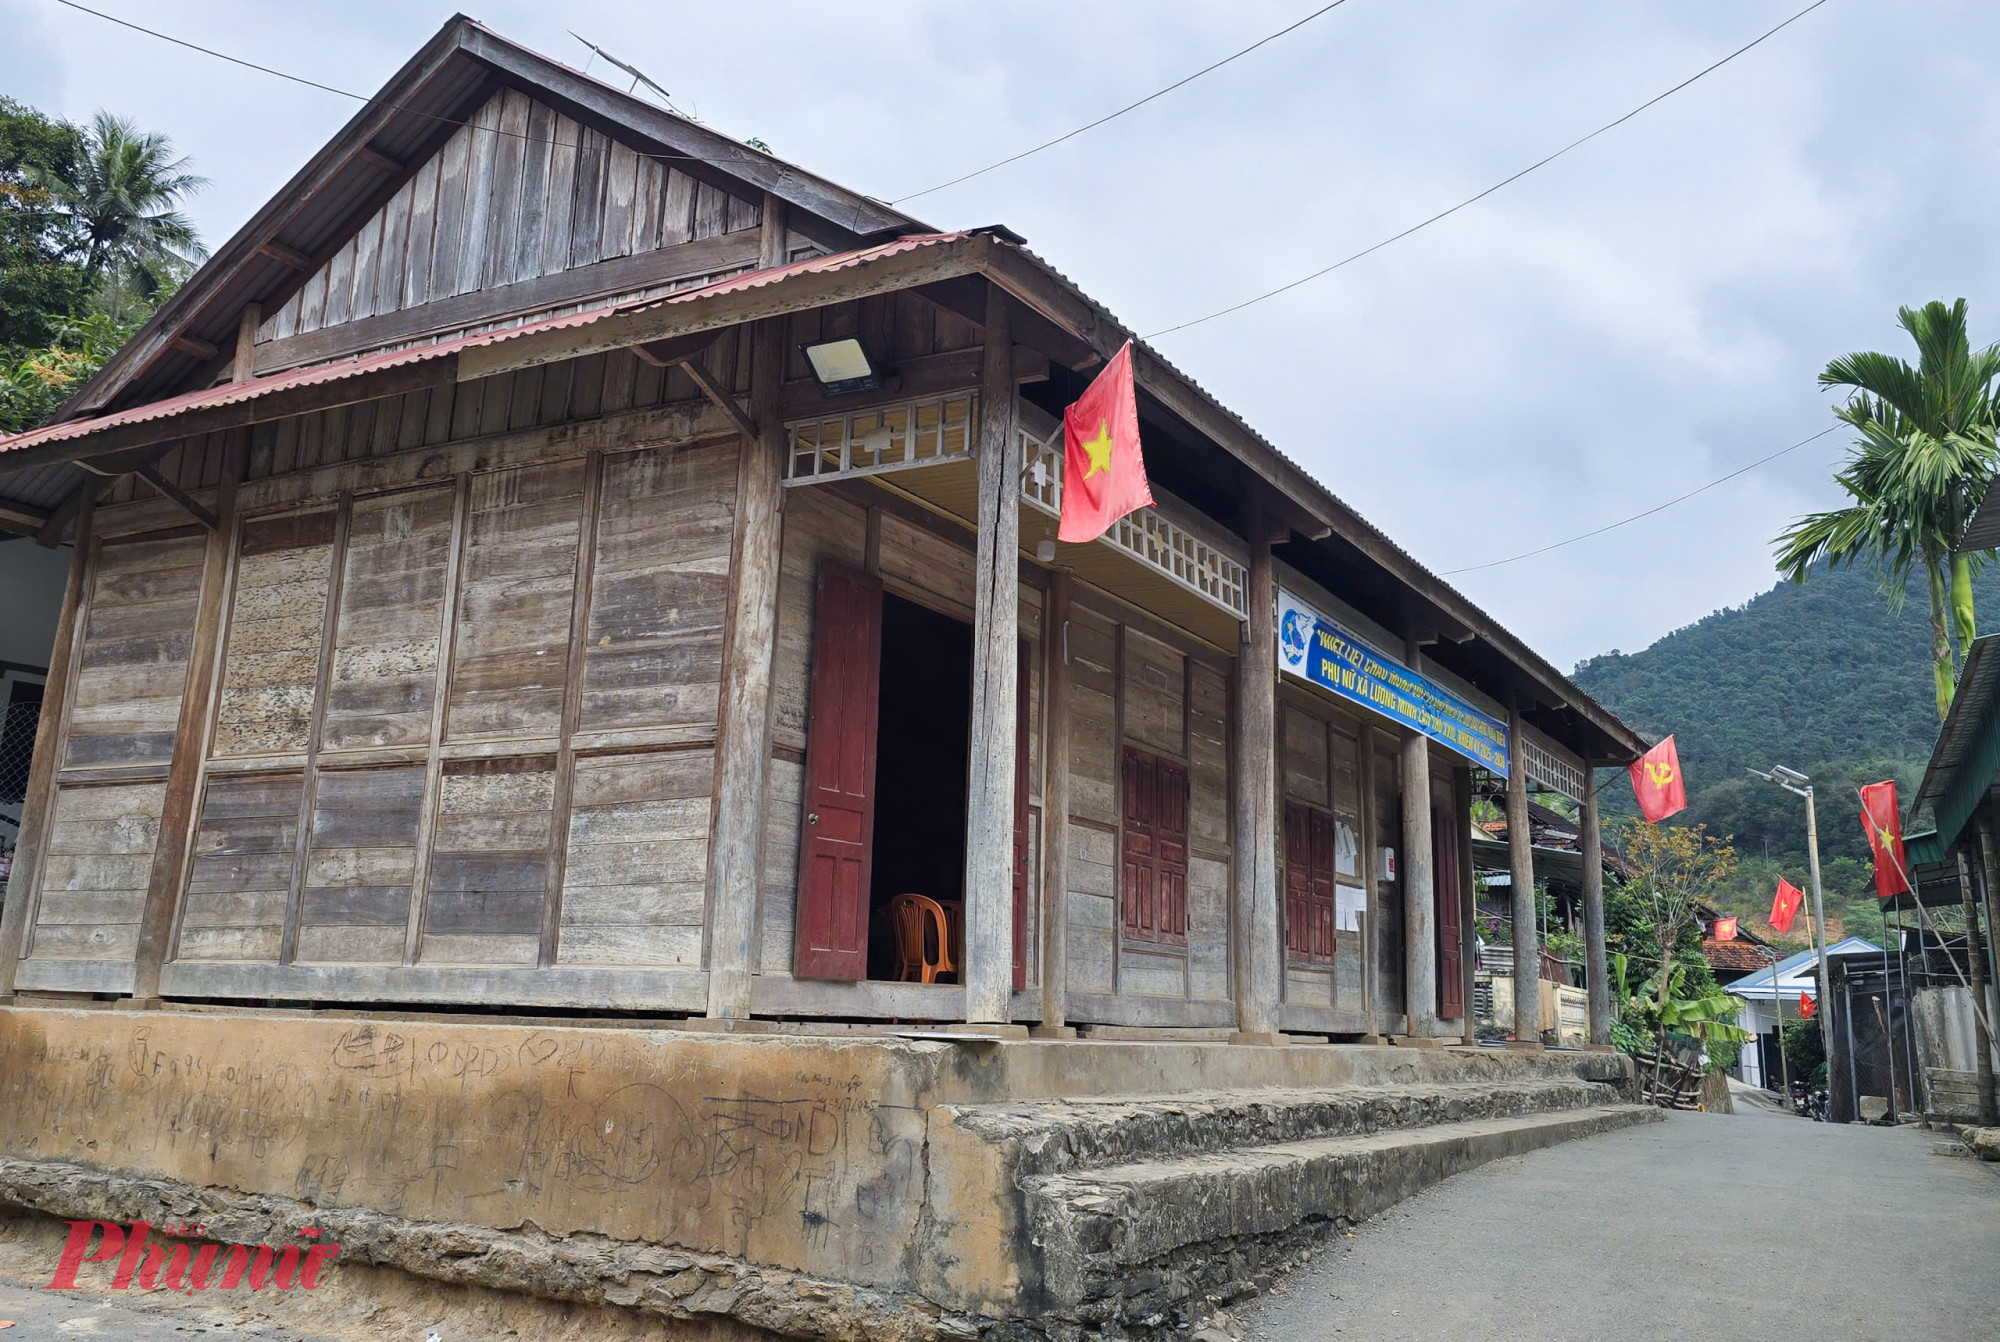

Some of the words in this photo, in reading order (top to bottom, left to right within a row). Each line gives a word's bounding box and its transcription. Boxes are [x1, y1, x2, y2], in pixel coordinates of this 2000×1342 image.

[1321, 658, 1340, 688] PHỤ
[1342, 668, 1357, 691] NỮ
[1356, 675, 1368, 698] XÃ
[1369, 682, 1396, 710] LƯỢNG
[1397, 696, 1417, 721] MINH
